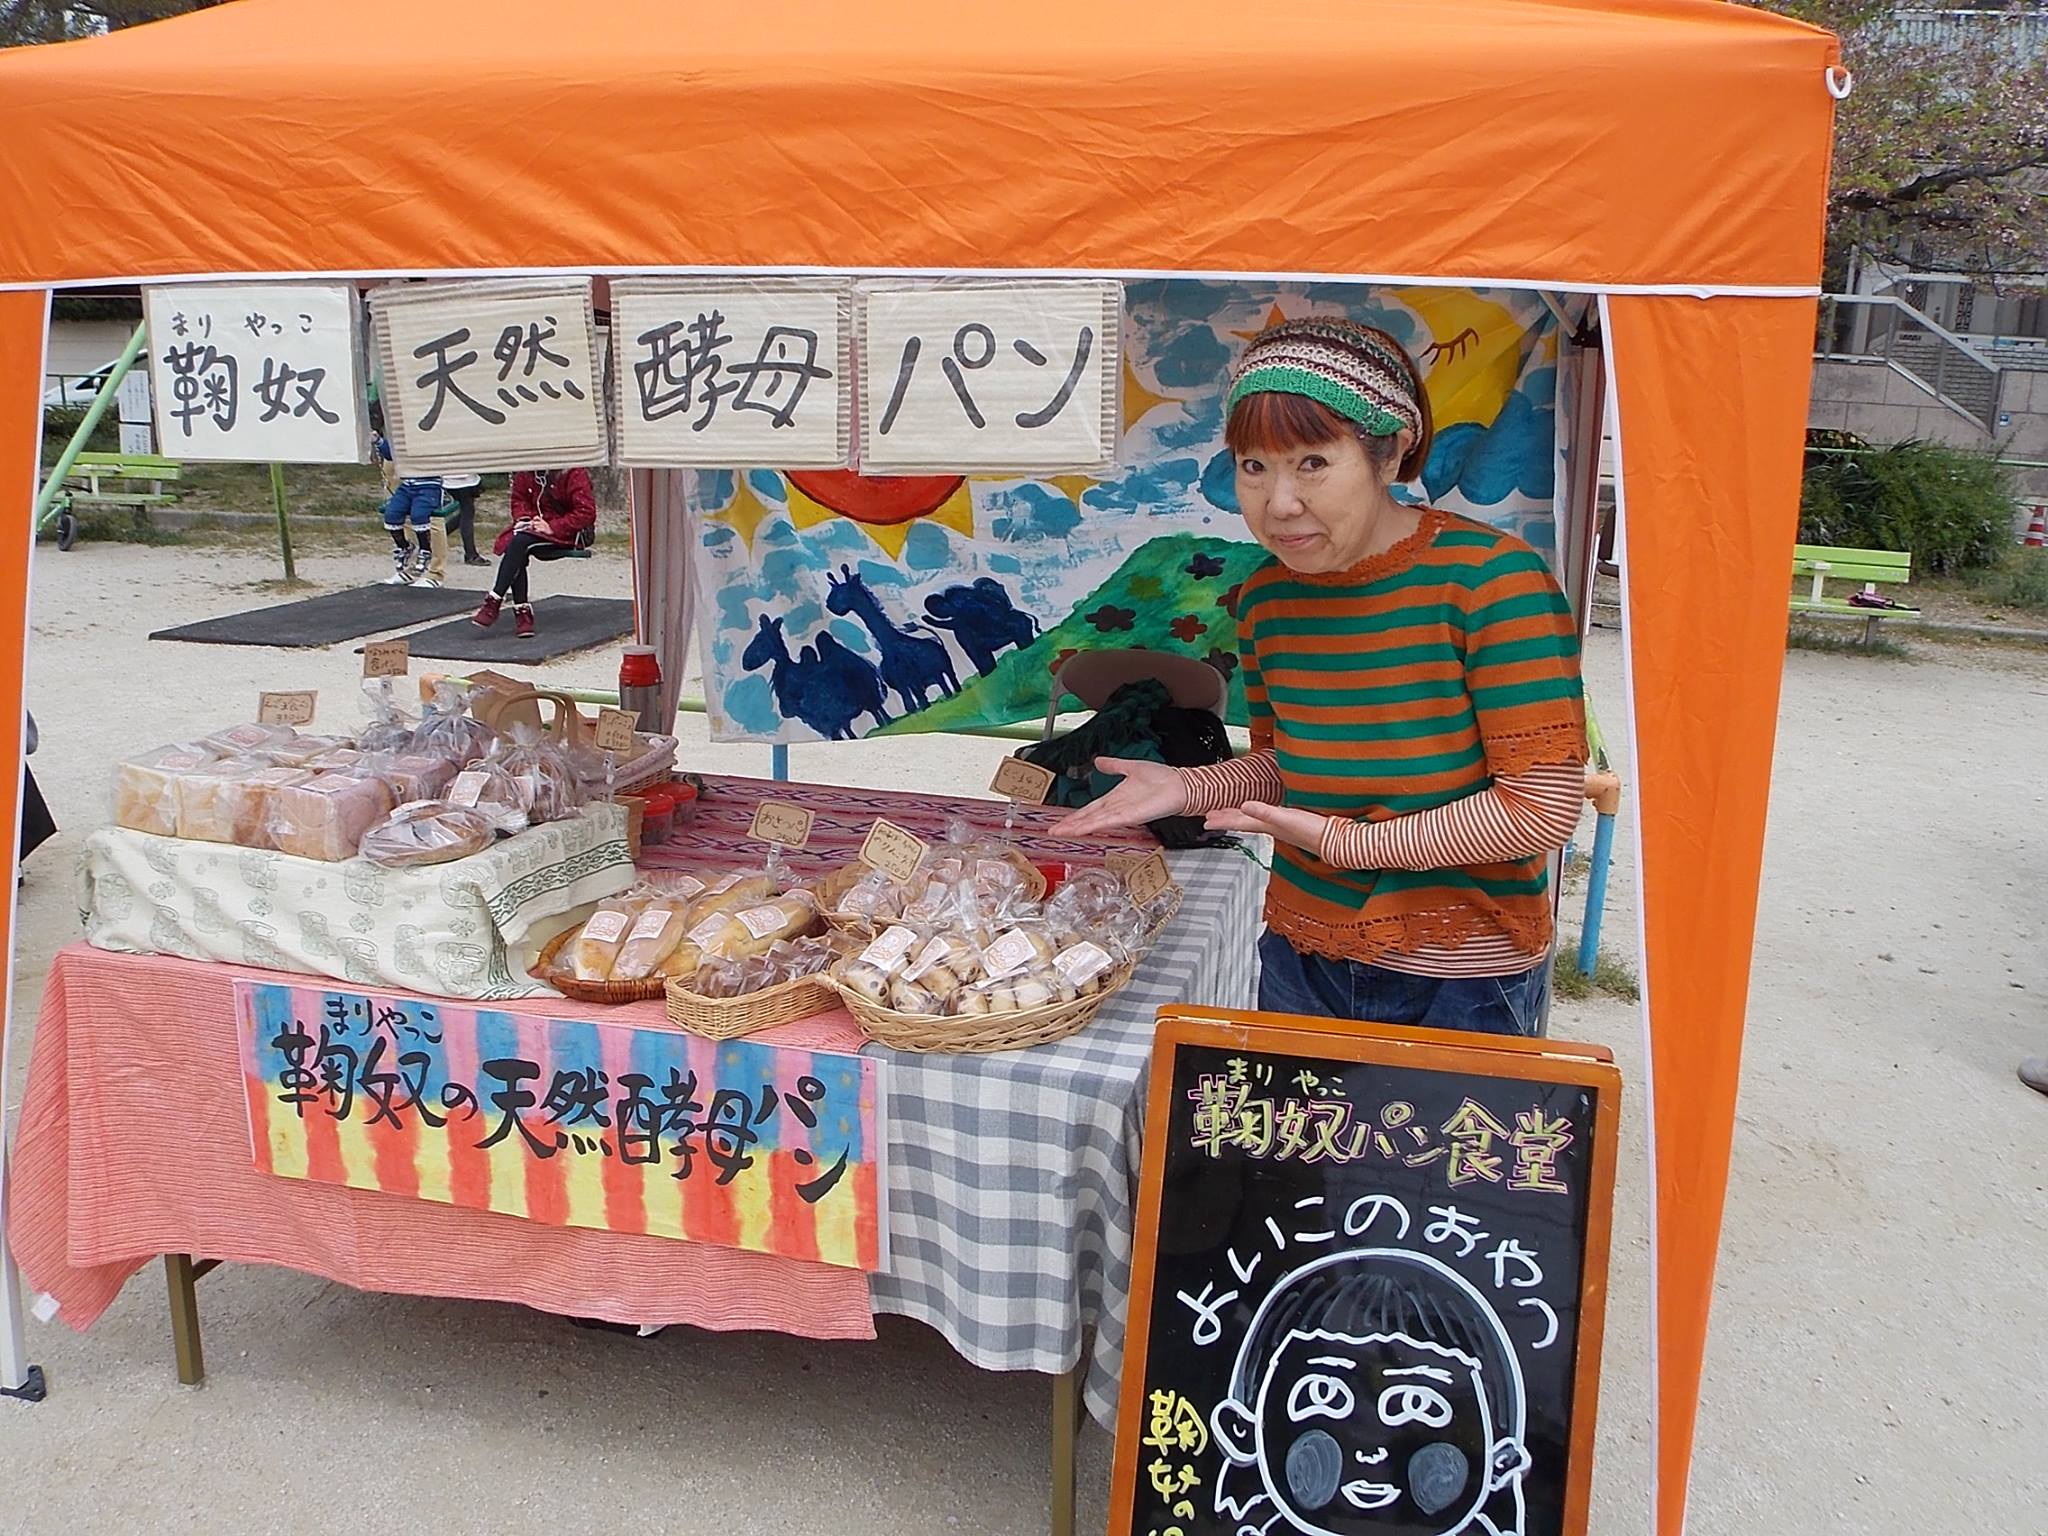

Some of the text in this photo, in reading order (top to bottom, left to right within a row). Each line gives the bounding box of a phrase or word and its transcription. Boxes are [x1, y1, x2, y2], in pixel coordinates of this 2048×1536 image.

[171, 311, 313, 339] まり やっこ
[413, 315, 586, 432] 天然
[634, 308, 833, 432] 酵母
[879, 322, 1094, 436] パン
[163, 341, 341, 437] 鞠奴
[326, 997, 443, 1044] まりやっこ
[1225, 1056, 1347, 1098] まり やっこ
[272, 1020, 852, 1204] 鞠奴の天然酵母パン
[1187, 1073, 1574, 1195] 鞠奴パン食堂
